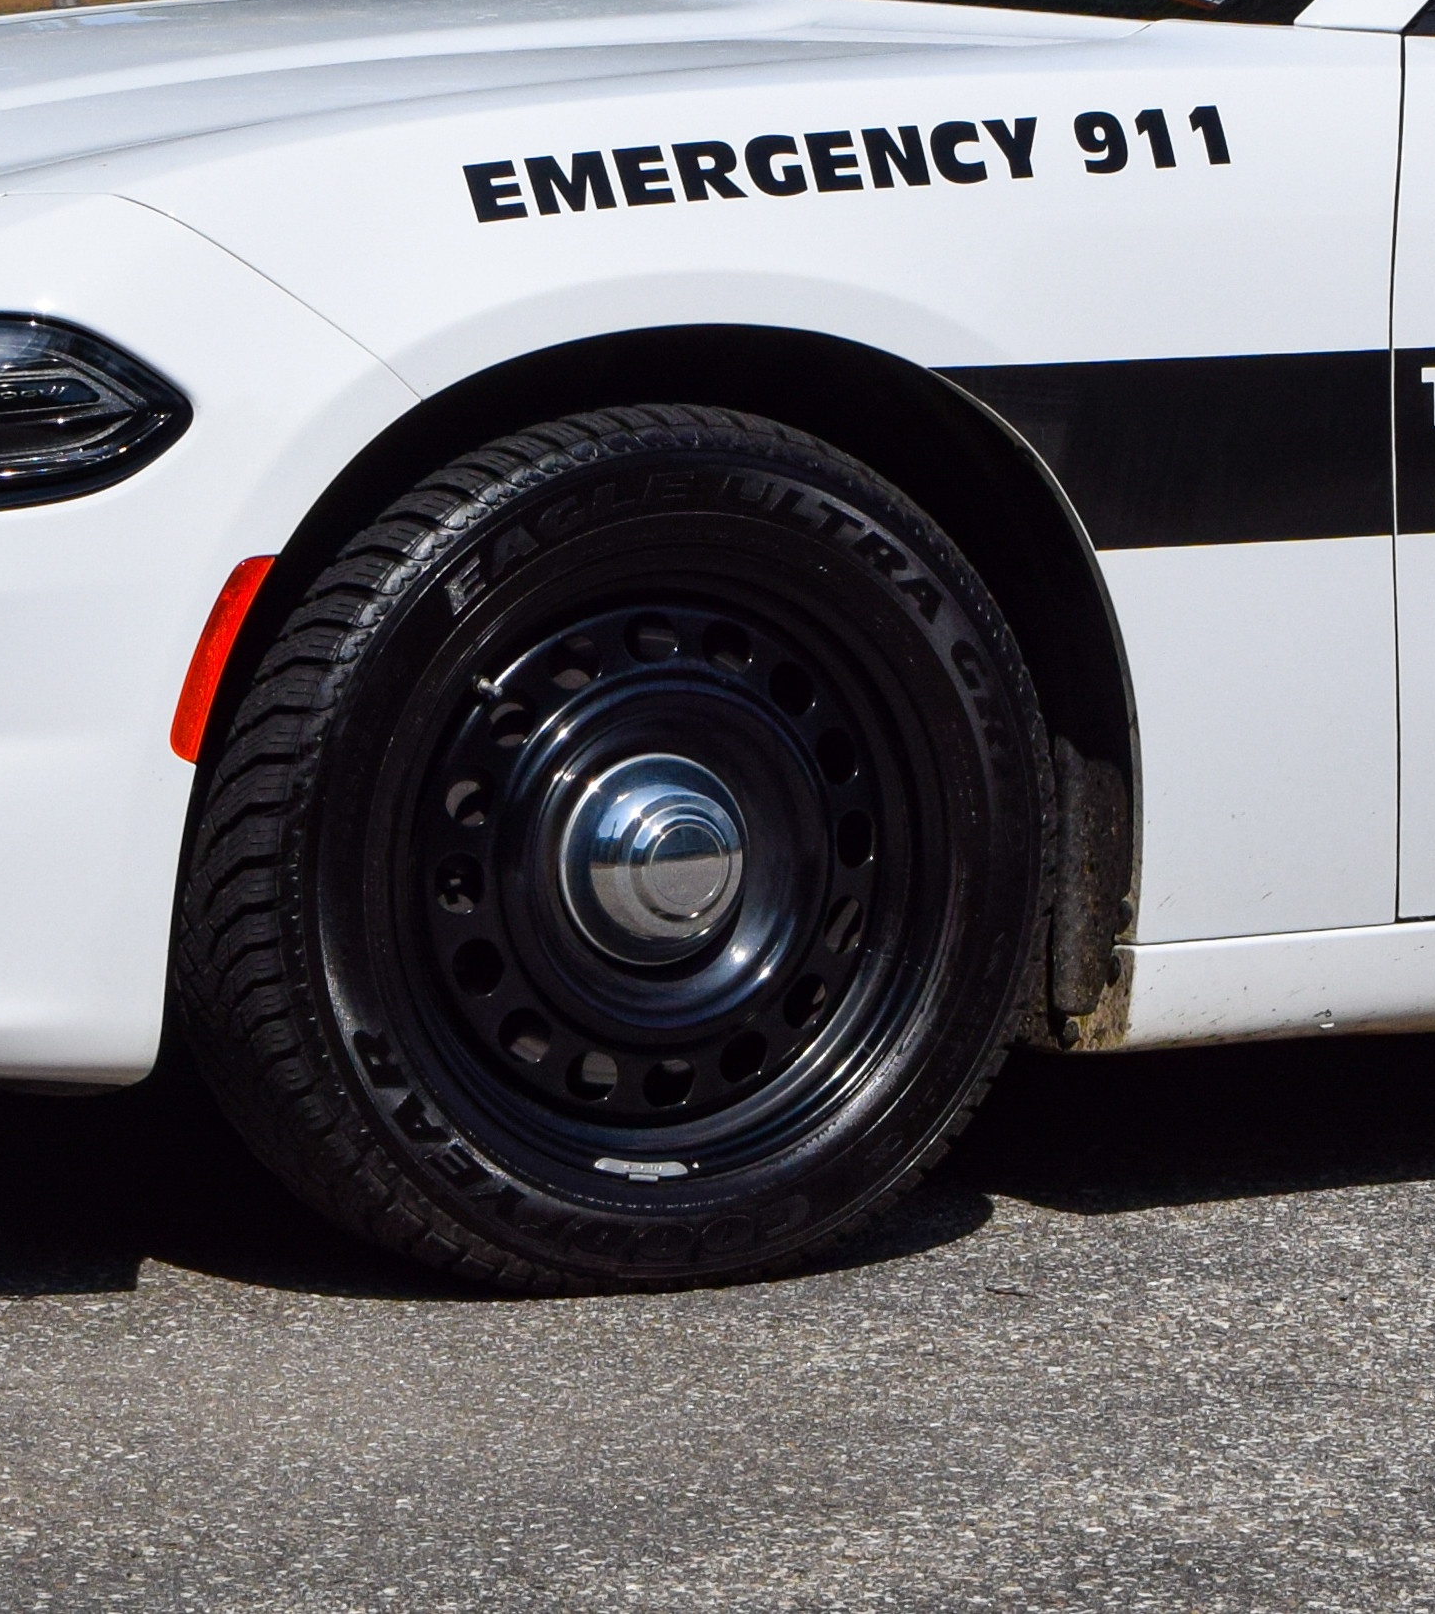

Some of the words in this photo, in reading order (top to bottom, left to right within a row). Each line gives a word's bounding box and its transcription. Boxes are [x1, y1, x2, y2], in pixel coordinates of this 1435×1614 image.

[462, 117, 1038, 223] EMERGENCY
[1073, 105, 1231, 175] 911
[443, 469, 695, 617] EAGLE
[721, 473, 947, 625] ULTRA
